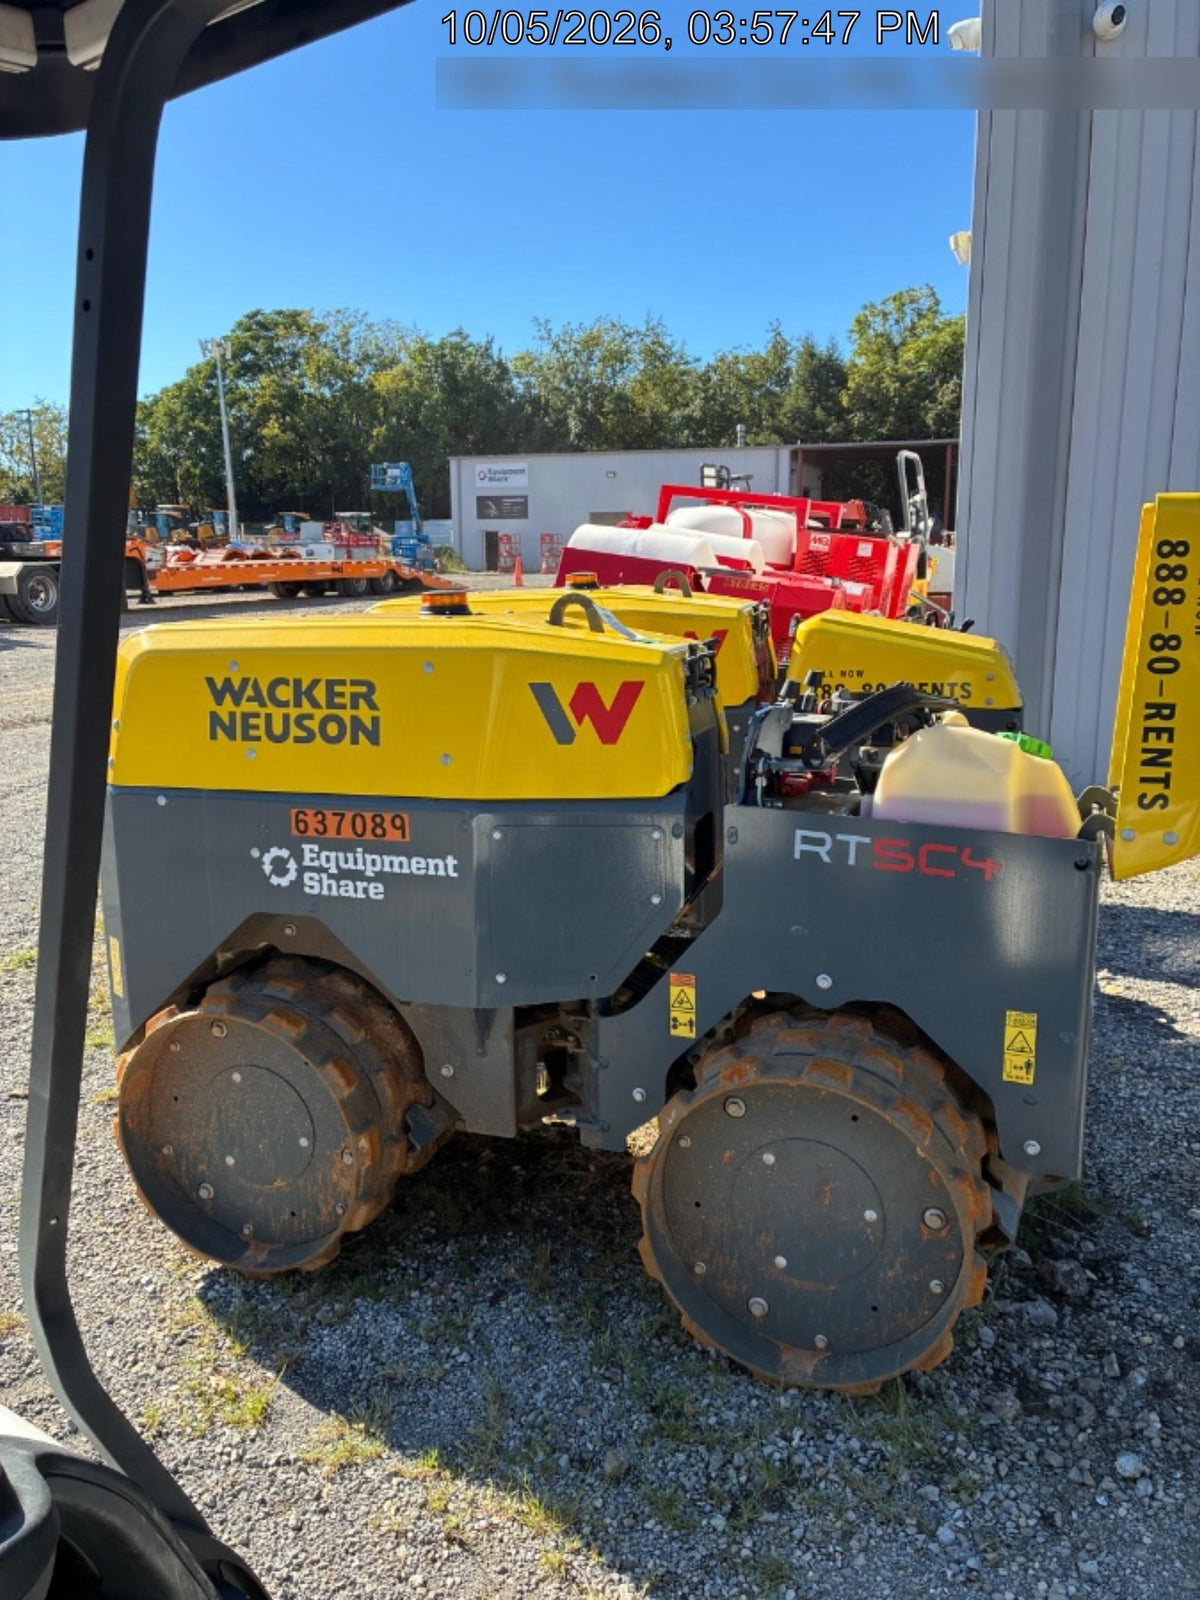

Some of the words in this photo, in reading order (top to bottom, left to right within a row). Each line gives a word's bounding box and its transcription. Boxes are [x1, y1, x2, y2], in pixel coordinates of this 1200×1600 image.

[840, 669, 865, 679] NOW
[1137, 538, 1190, 812] 888-80-RENTS
[204, 676, 381, 711] WACKER
[208, 710, 381, 747] NEUSON
[294, 810, 407, 839] 637089
[301, 844, 459, 877] Equipment
[303, 871, 385, 900] Share
